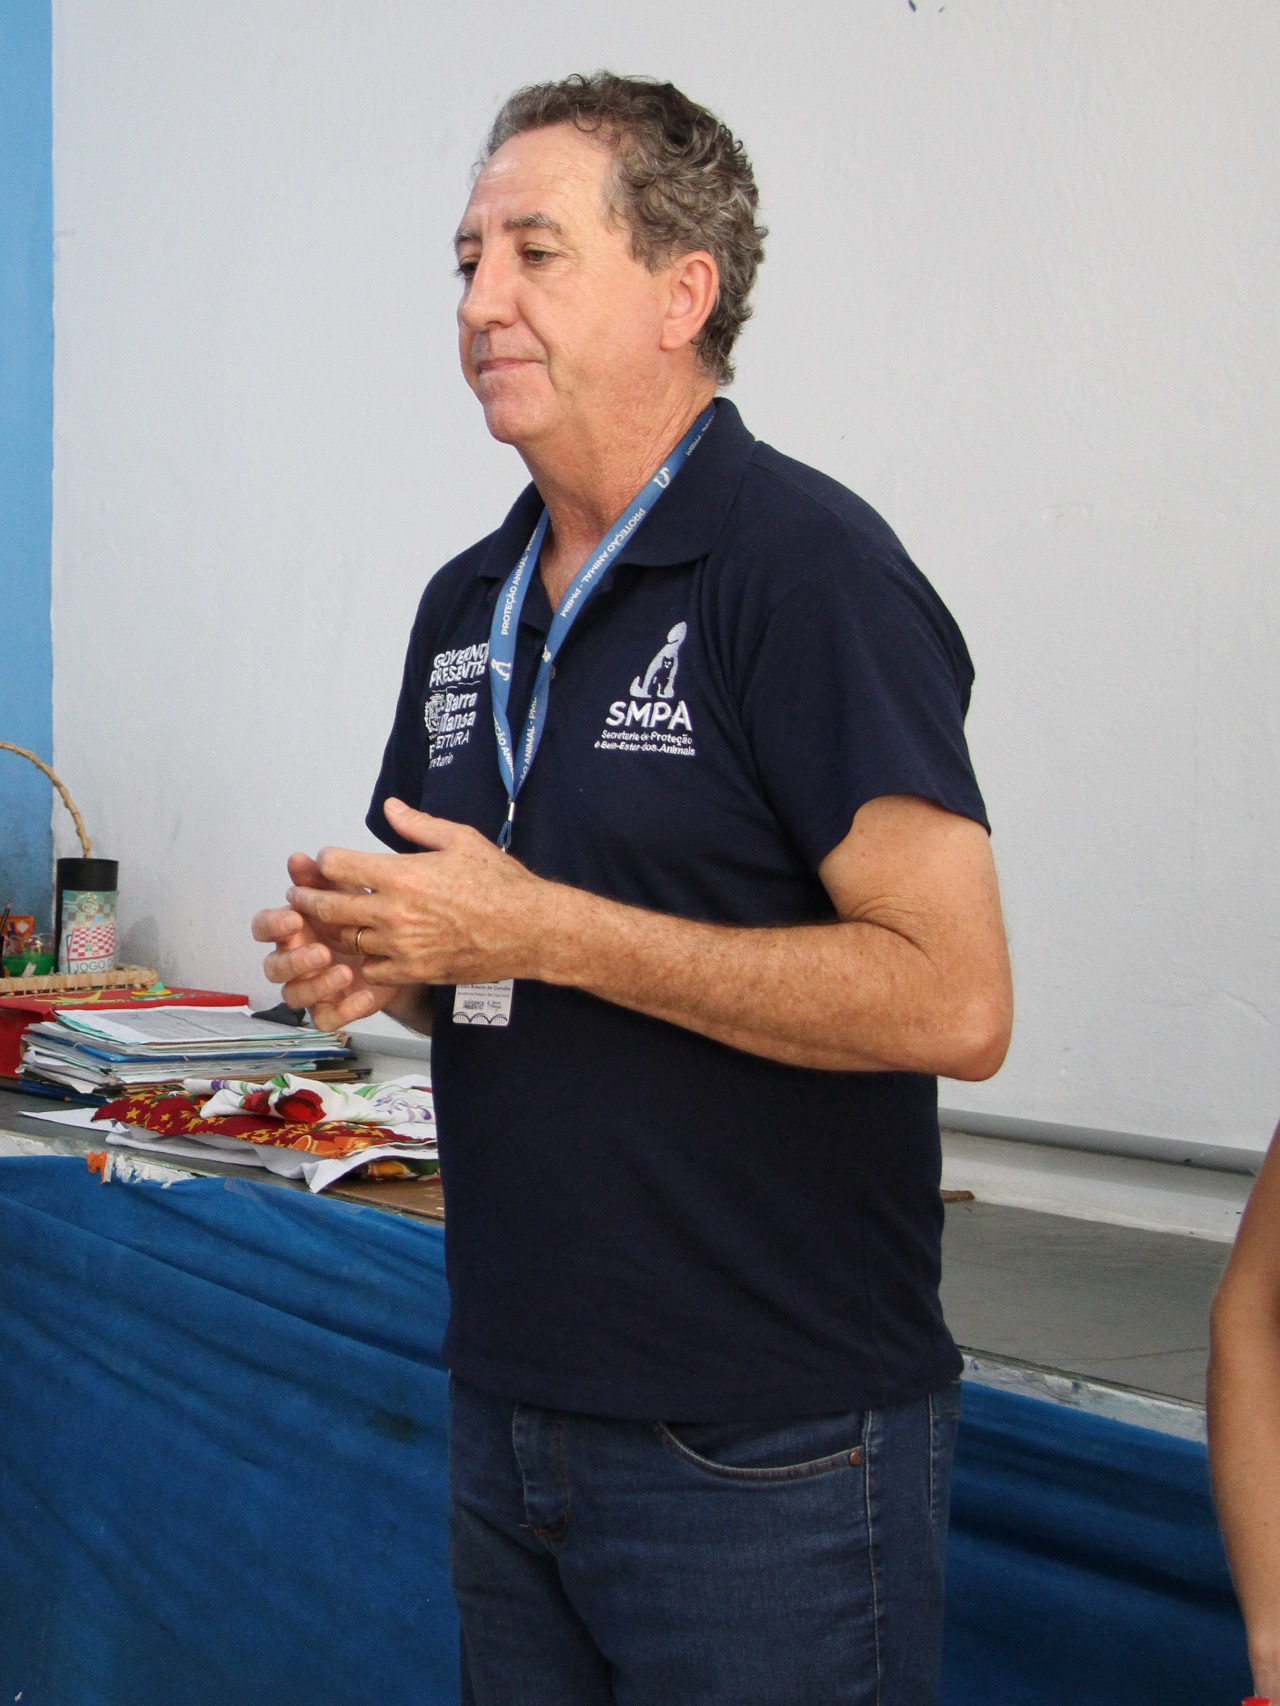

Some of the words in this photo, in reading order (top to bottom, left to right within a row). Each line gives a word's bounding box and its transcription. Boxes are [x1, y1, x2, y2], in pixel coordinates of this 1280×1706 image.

[607, 507, 646, 553] PROTEÇÃO
[581, 550, 609, 583] ANIMAL
[501, 586, 517, 636] PROTEÇÃO
[512, 554, 529, 586] ANIMAL
[560, 587, 582, 618] PMBM
[445, 692, 478, 713] Barra
[605, 700, 693, 732] SMPA
[524, 725, 536, 765] ANIMAL
[650, 731, 693, 746] Proteção
[658, 743, 696, 756] Animais
[73, 960, 106, 973] JOGO
